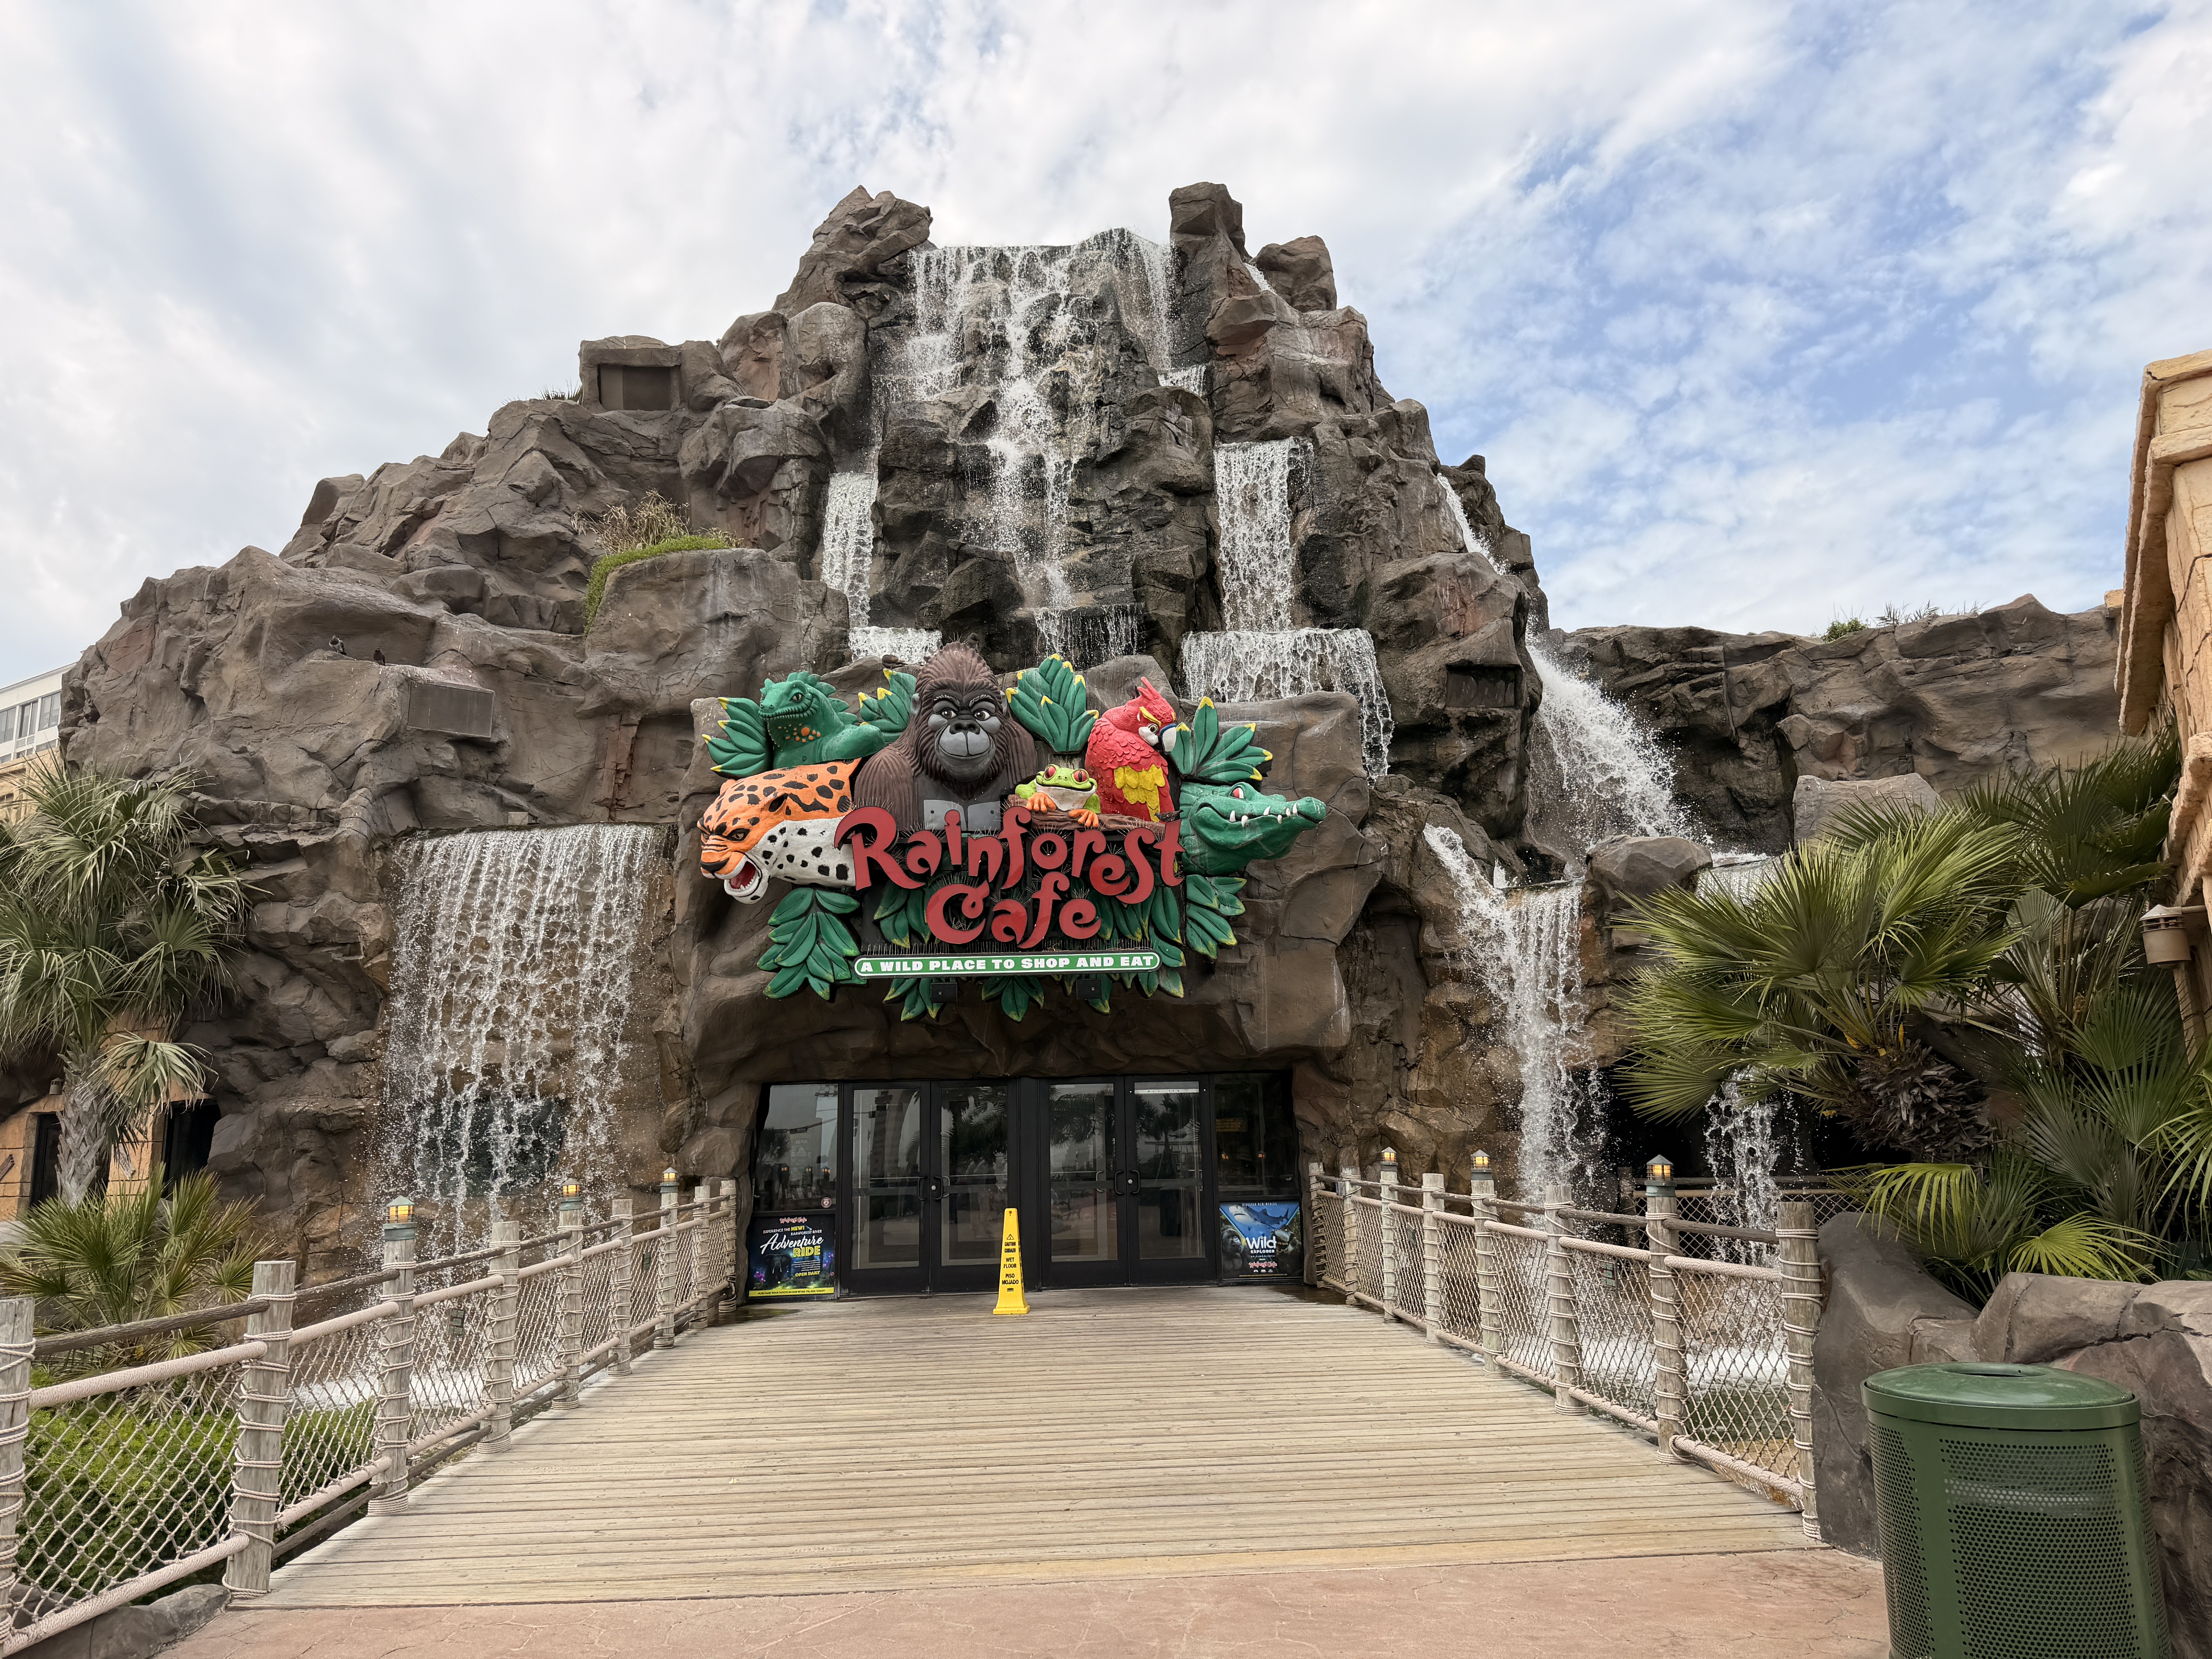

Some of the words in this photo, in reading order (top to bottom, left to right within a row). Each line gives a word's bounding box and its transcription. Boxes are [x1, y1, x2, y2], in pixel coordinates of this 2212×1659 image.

[834, 806, 1186, 904] Rainforest
[927, 871, 1101, 948] Cafe
[860, 962, 873, 972] A
[880, 961, 923, 972] WILD
[929, 960, 986, 971] PLACE
[992, 958, 1015, 969] TO
[1021, 958, 1070, 969] SHOP
[1076, 957, 1114, 967] AND
[1120, 956, 1154, 966] EAT
[760, 1233, 824, 1255] Adventure
[793, 1245, 821, 1258] RIDE
[1246, 1235, 1277, 1249] Wild
